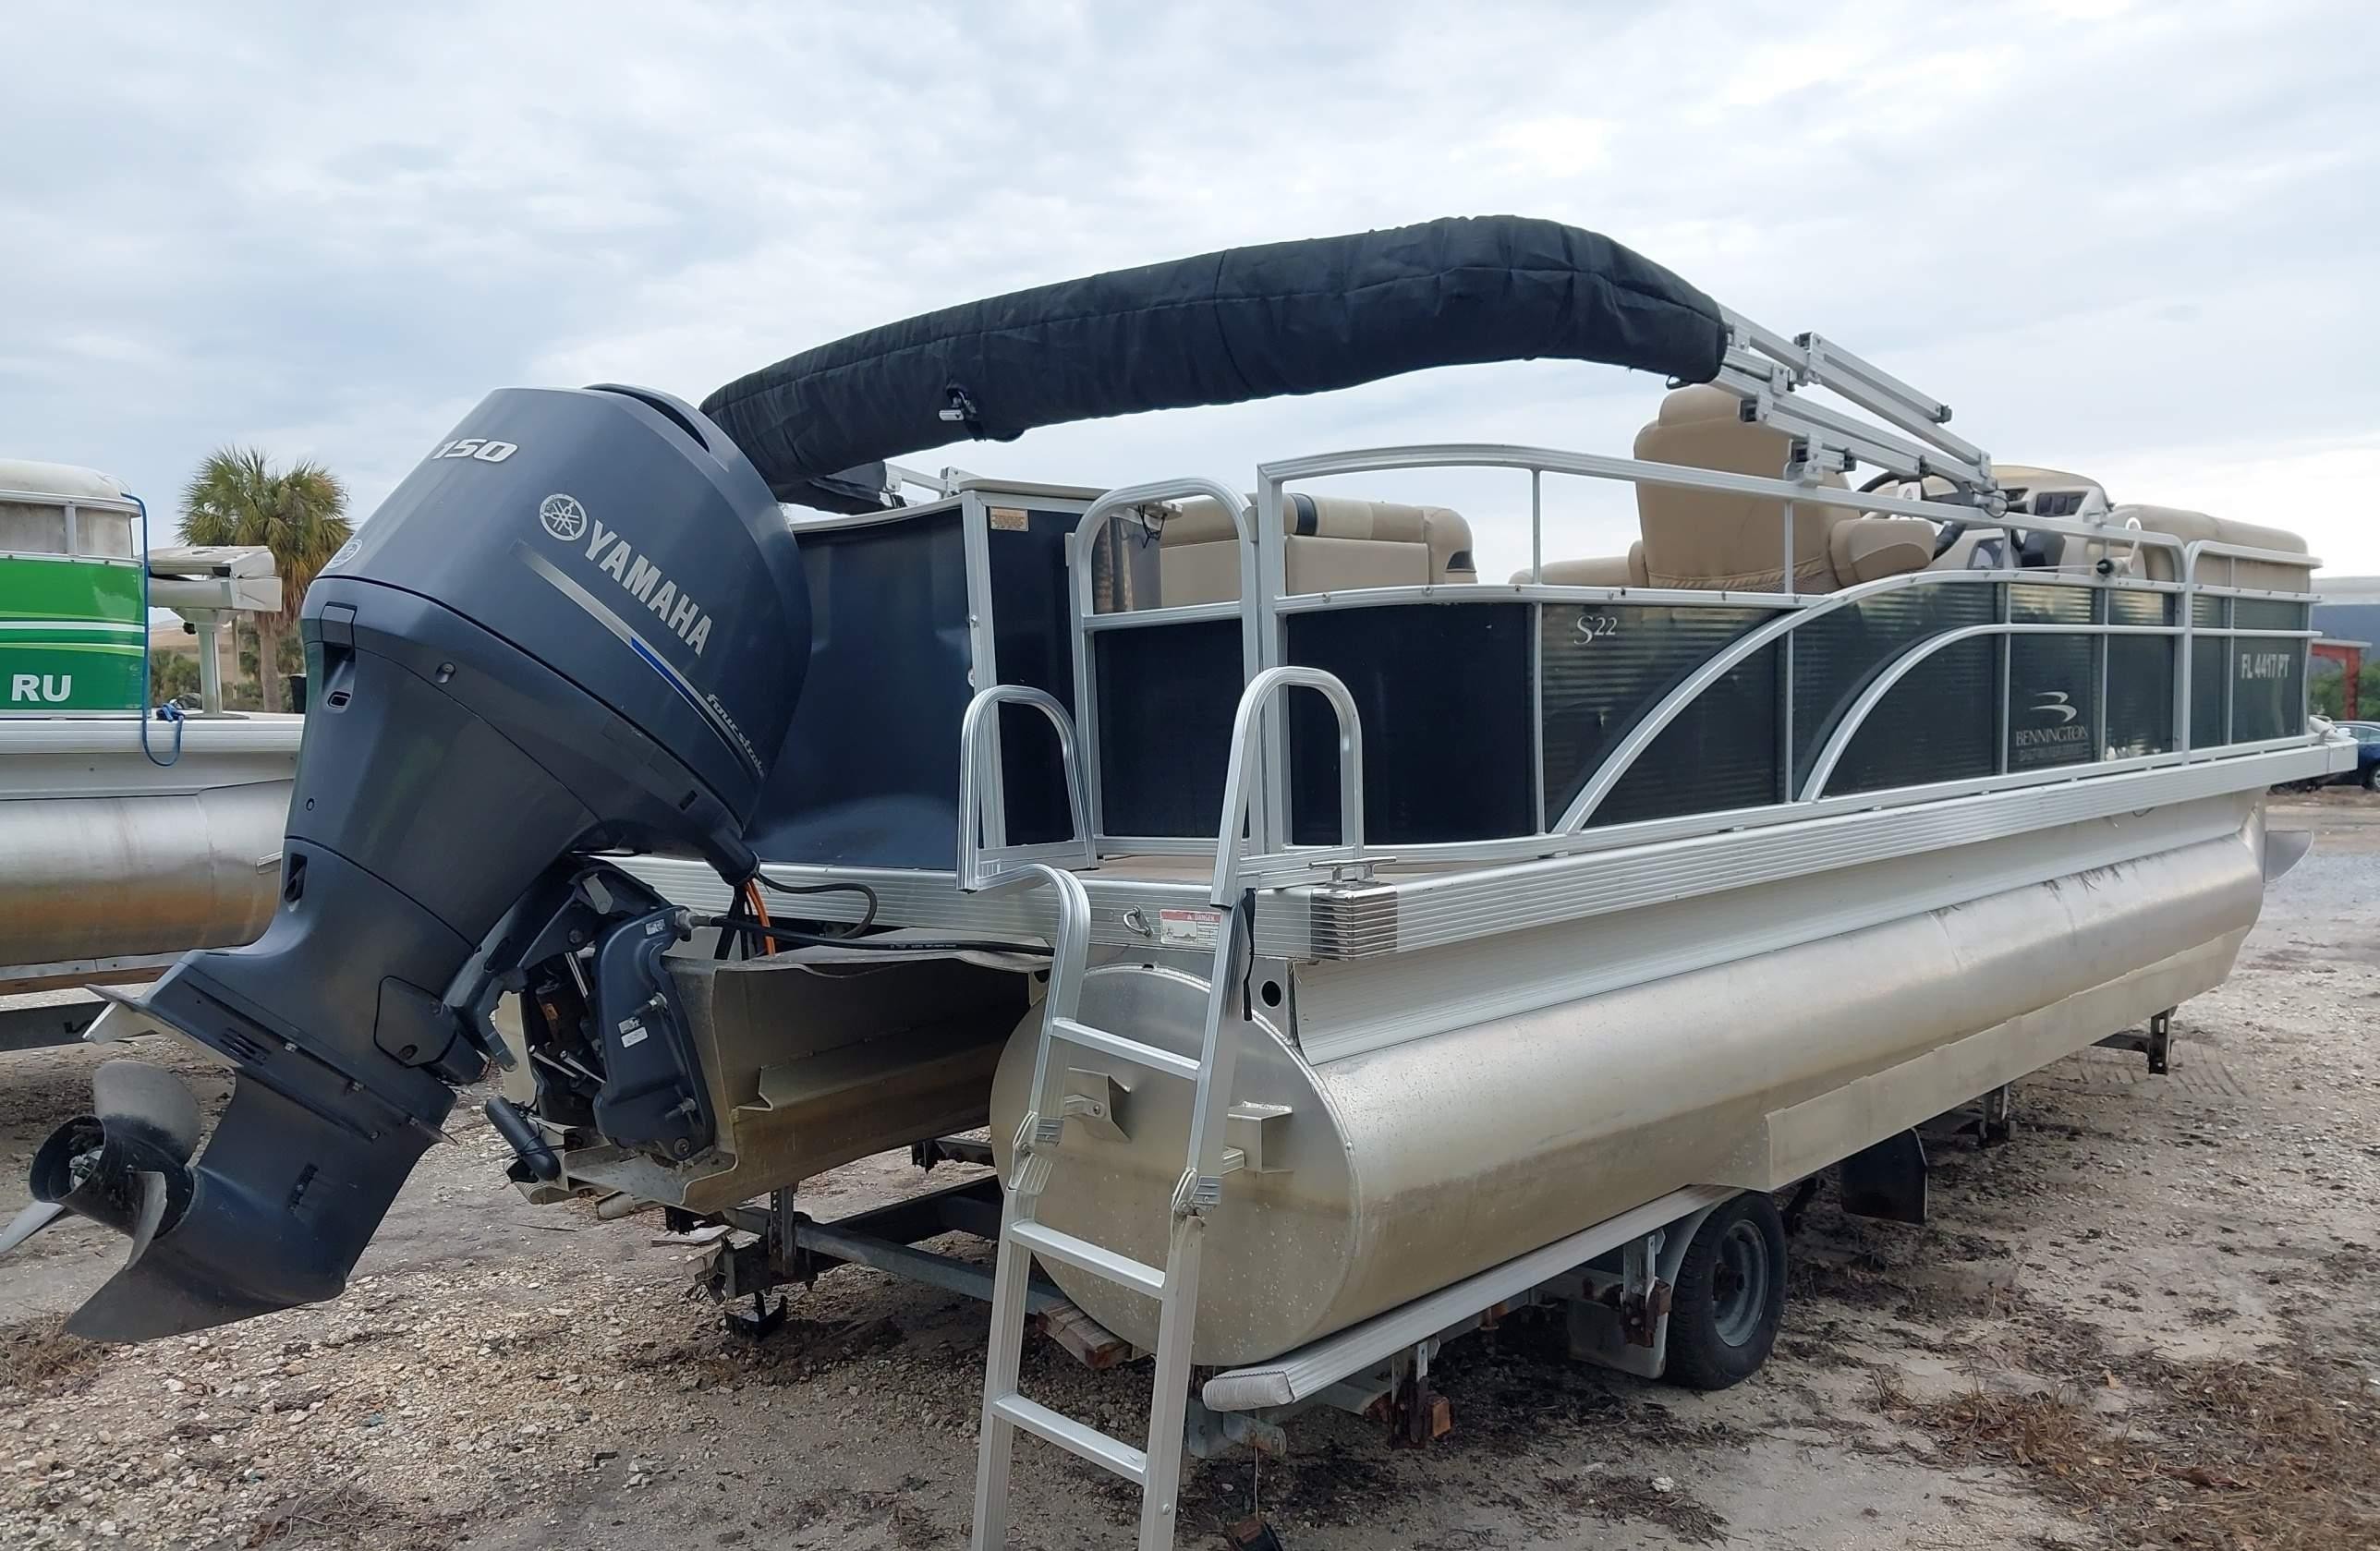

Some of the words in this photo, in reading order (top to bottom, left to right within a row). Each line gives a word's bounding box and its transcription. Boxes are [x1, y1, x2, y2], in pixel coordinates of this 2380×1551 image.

[431, 438, 519, 463] 150
[584, 518, 712, 658] YAMAHA
[1573, 615, 1618, 645] S22
[2241, 653, 2253, 679] FL
[2254, 653, 2277, 679] 4417
[2277, 653, 2290, 679] PT
[11, 673, 72, 702] RU
[2015, 724, 2089, 747] BENNINGTON
